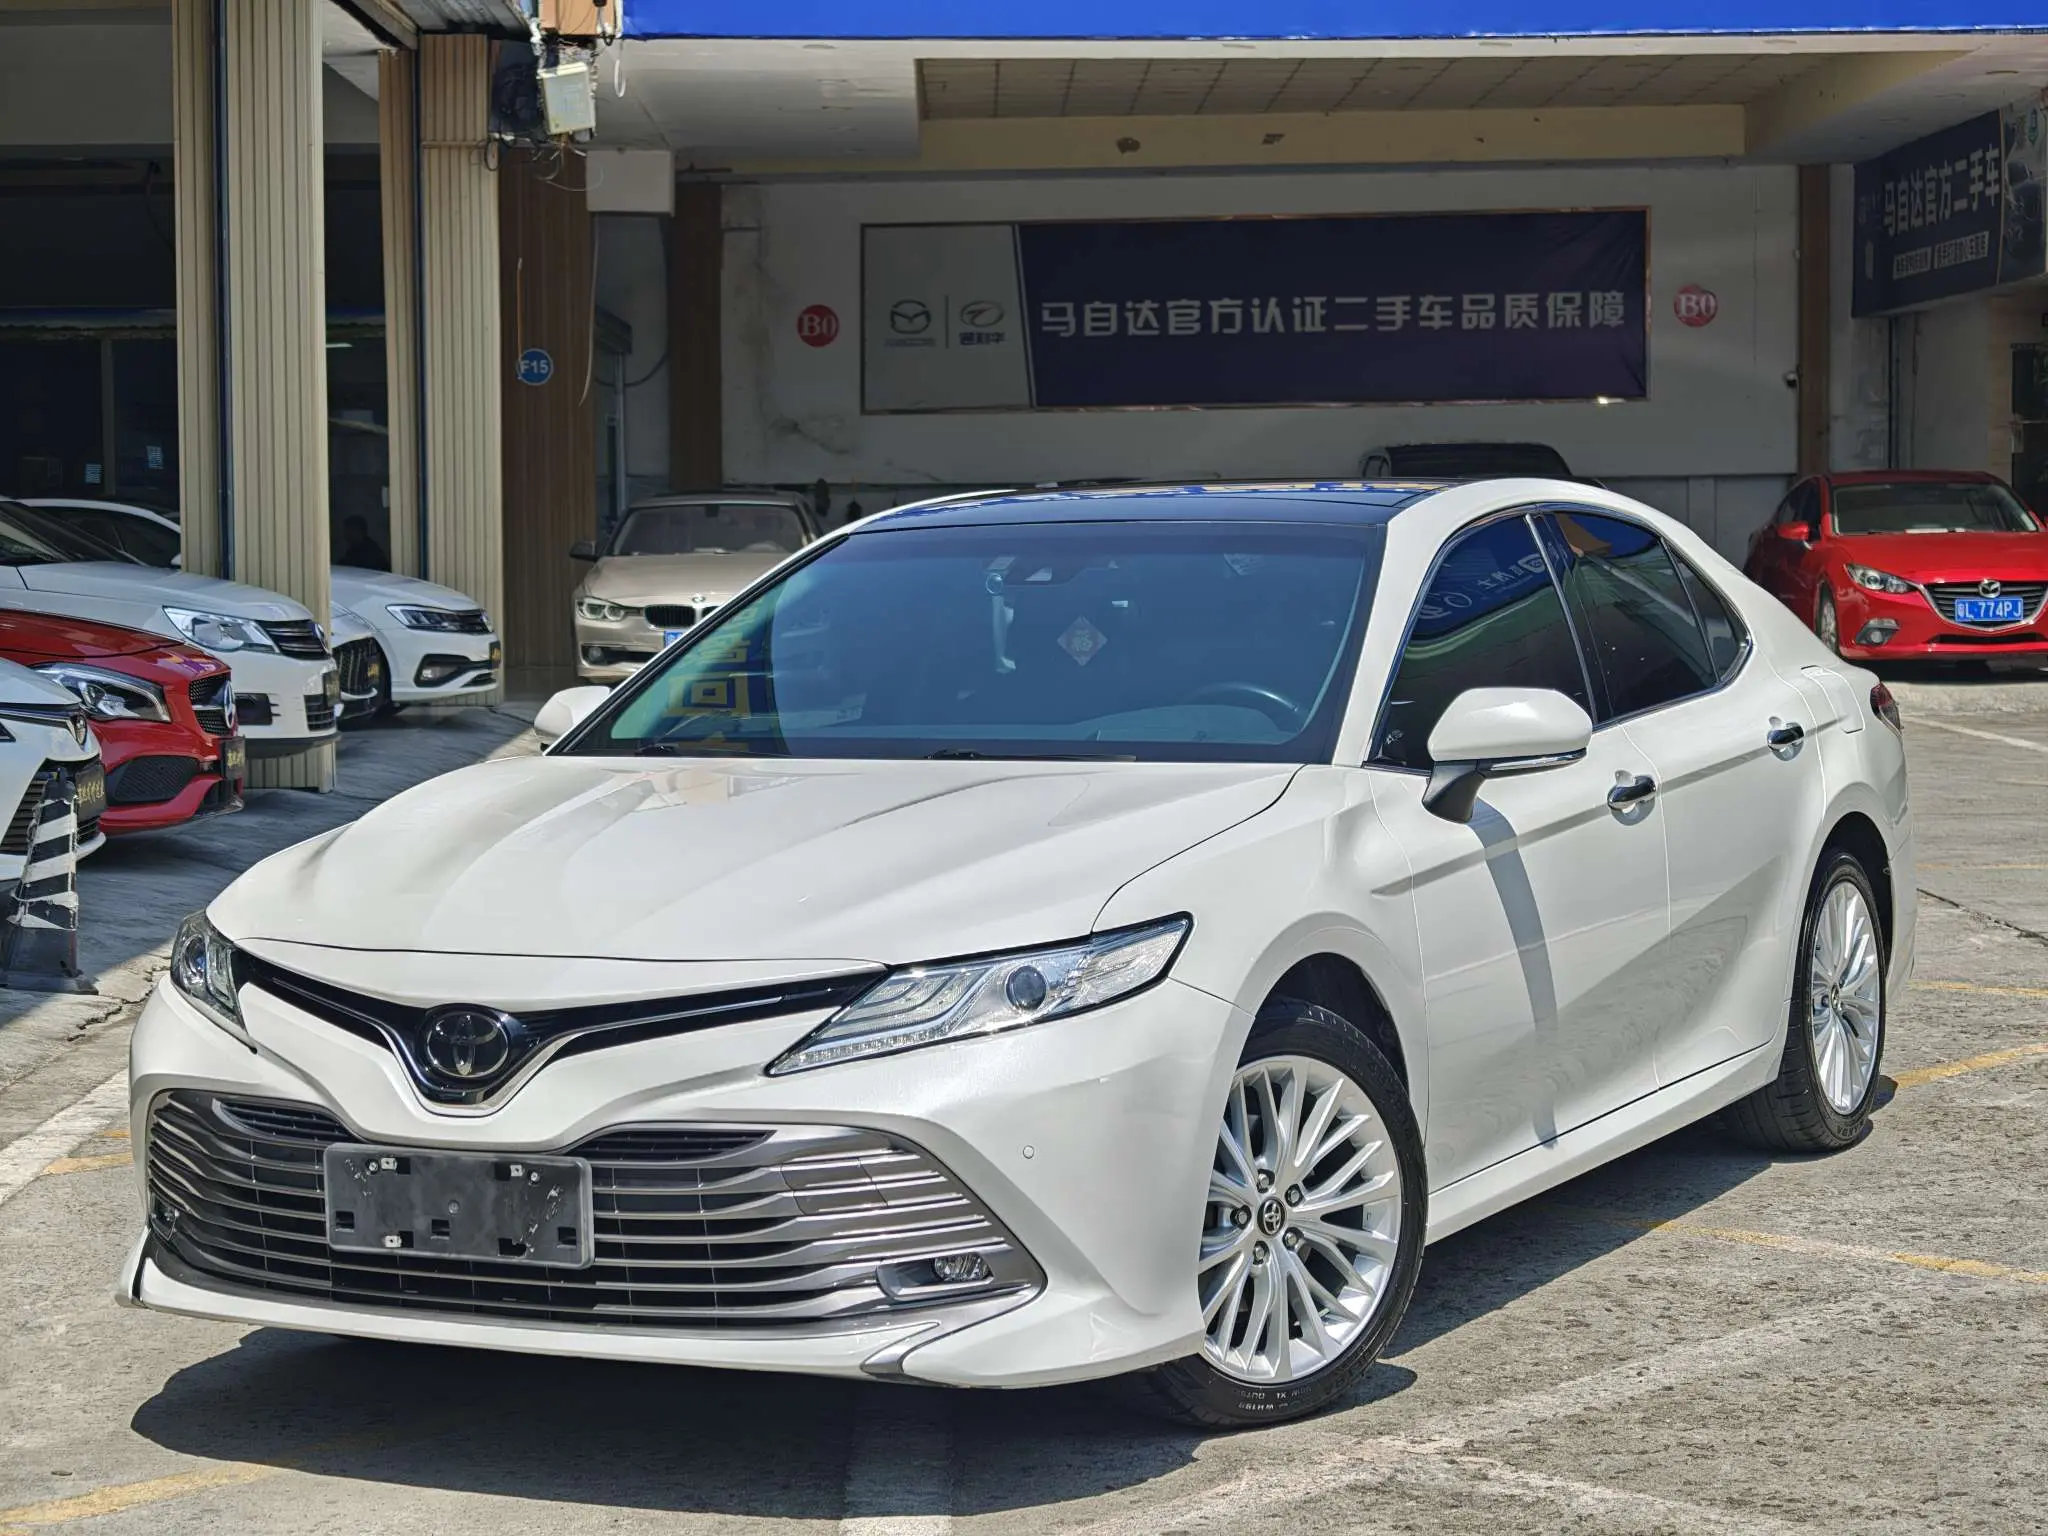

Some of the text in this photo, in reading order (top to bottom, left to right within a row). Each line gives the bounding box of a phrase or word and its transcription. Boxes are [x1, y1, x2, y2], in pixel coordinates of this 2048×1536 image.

[1883, 142, 2001, 238] 马自达官方二手车
[1041, 289, 1625, 338] 马自达官方认证二手车品质保障
[520, 359, 549, 374] F15
